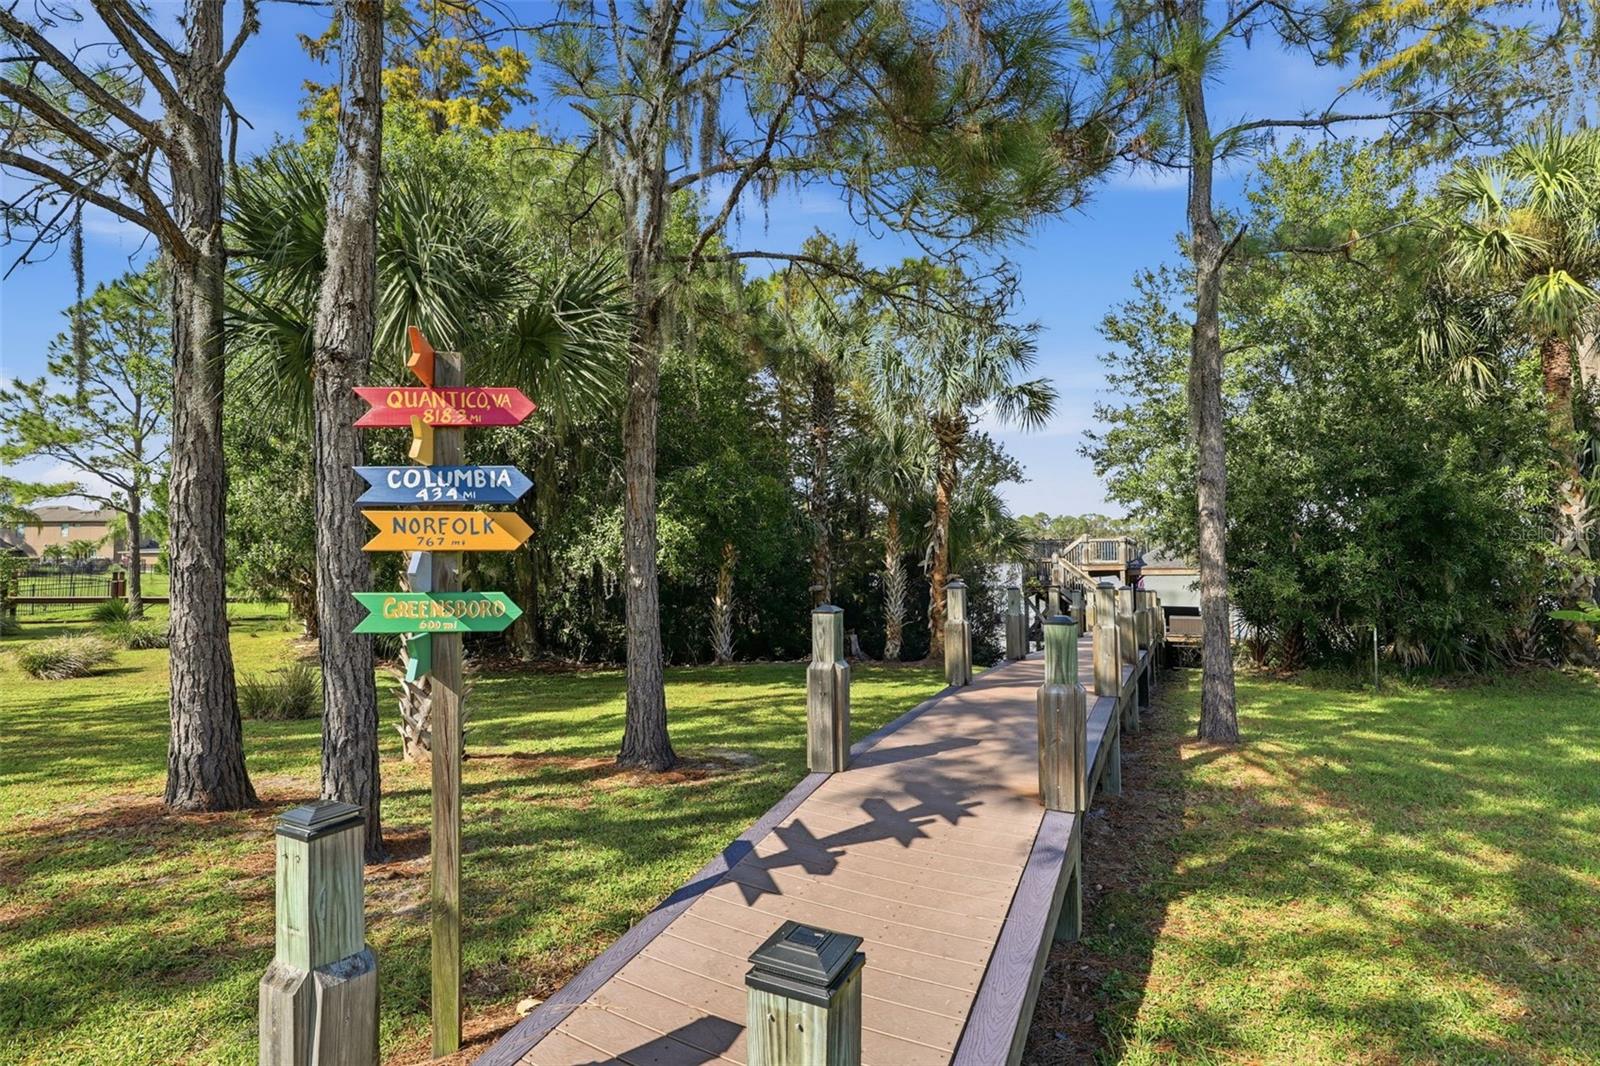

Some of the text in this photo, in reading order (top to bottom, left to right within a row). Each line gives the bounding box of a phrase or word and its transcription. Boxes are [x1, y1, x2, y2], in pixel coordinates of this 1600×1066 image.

[470, 414, 482, 422] MI
[387, 469, 512, 488] COLUMBIA
[416, 487, 476, 500] 434 MI
[392, 517, 495, 535] NORFOLK
[417, 537, 445, 547] 767
[383, 596, 506, 619] GREENSBORO
[419, 621, 441, 630] 600
